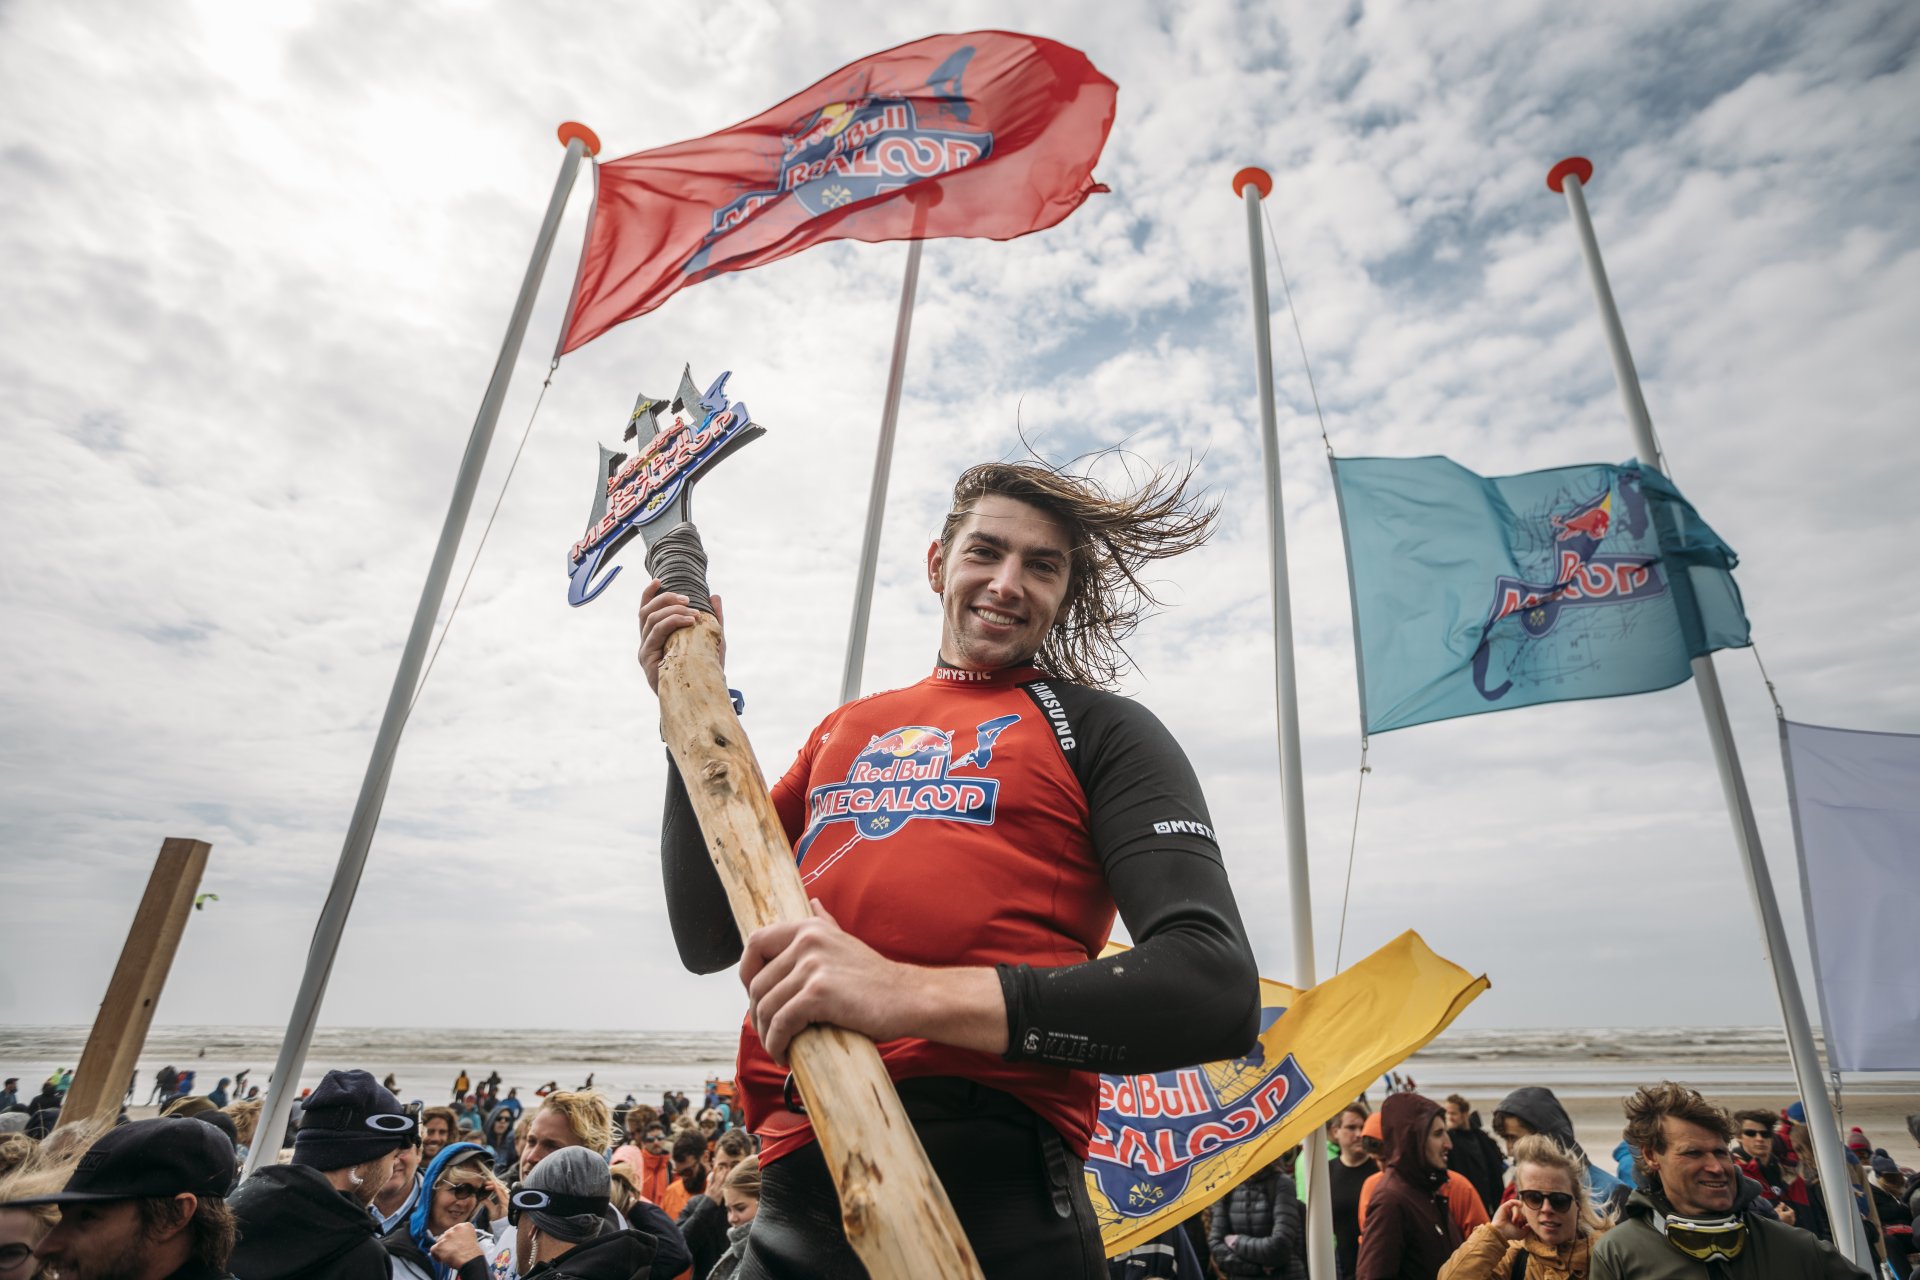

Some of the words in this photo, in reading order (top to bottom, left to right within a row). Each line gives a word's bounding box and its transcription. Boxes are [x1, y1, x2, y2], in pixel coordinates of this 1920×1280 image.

[845, 104, 908, 151] Bull
[610, 464, 651, 510] Red
[651, 427, 693, 473] Bull
[942, 668, 992, 681] MYSTIC
[1028, 681, 1077, 751] SAMSUNG
[851, 759, 899, 783] Red
[896, 755, 945, 782] Bull
[813, 784, 986, 818] MEGALOOP
[1043, 1037, 1127, 1061] MAJESTIC
[1099, 1074, 1139, 1117] ed
[1135, 1069, 1211, 1119] Bull
